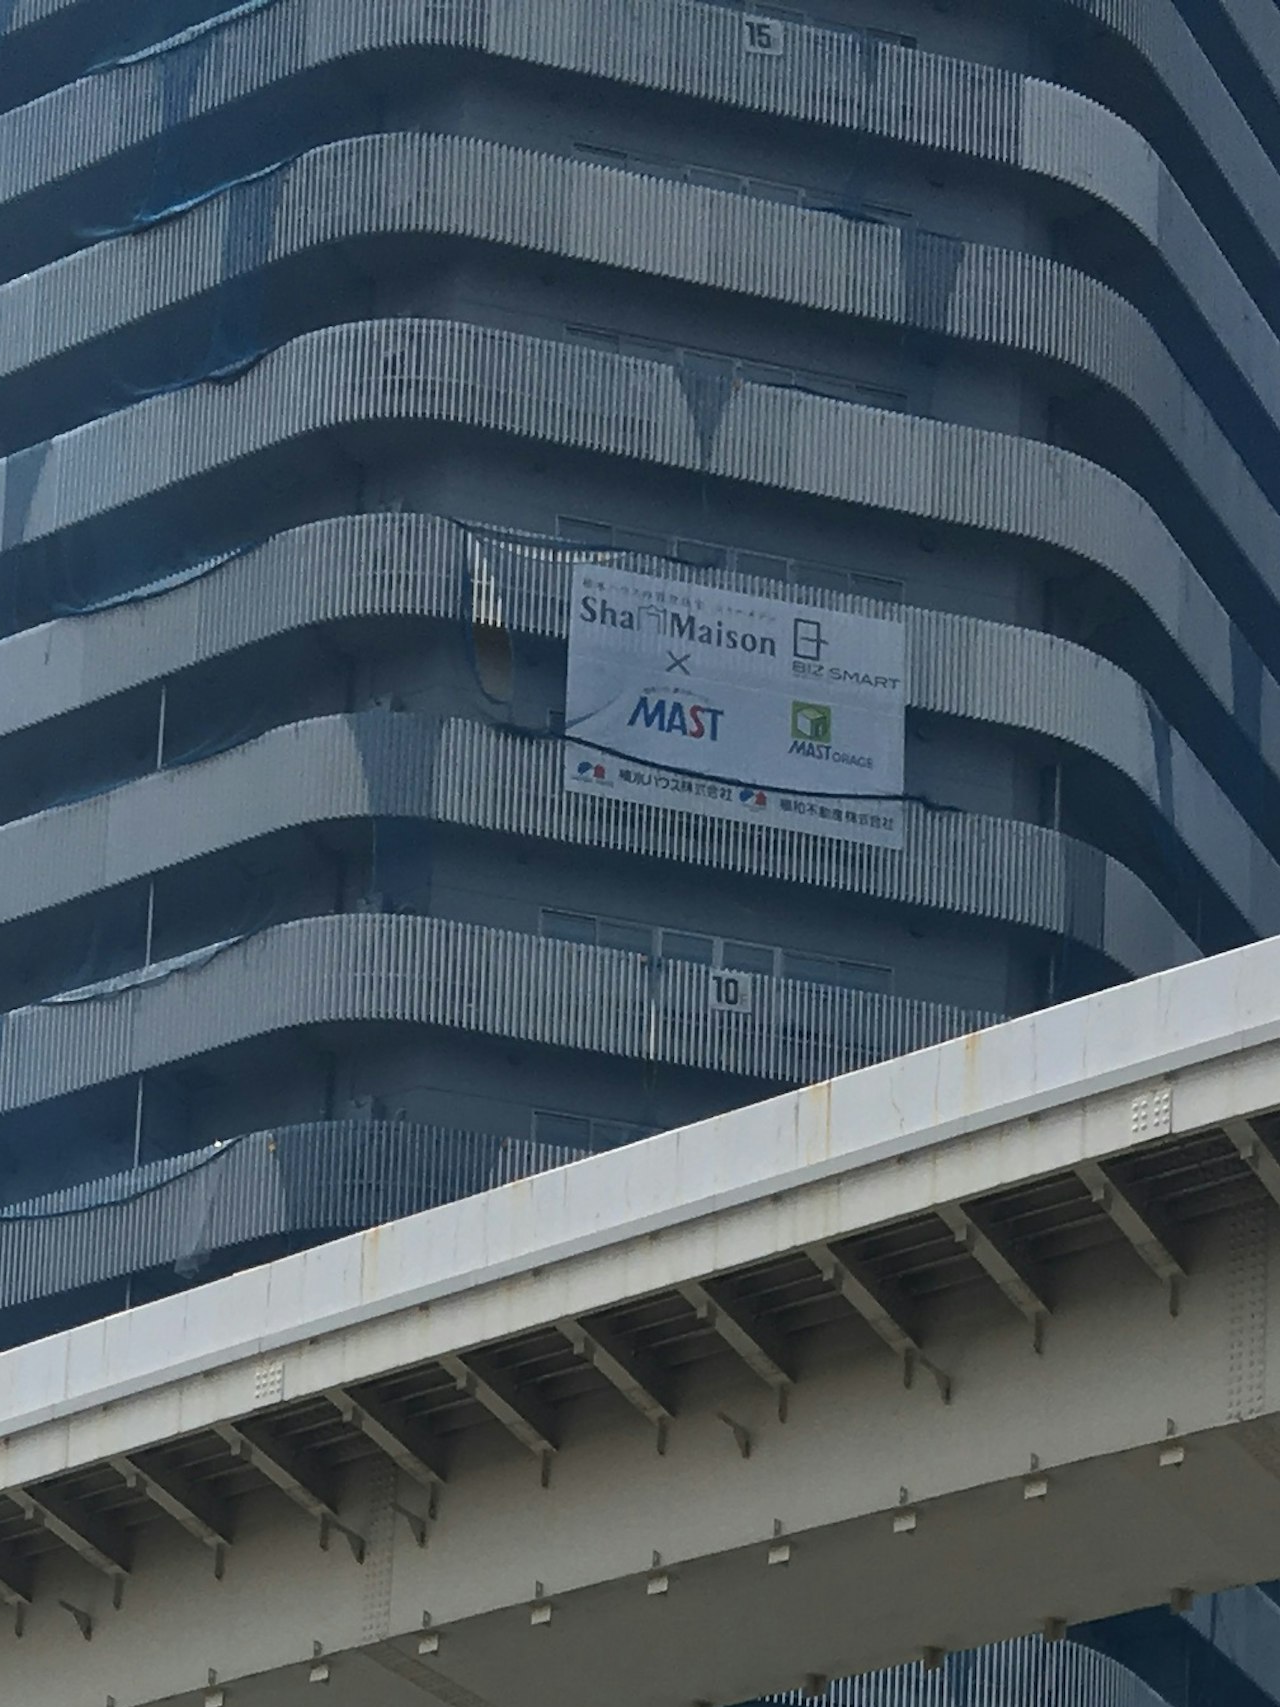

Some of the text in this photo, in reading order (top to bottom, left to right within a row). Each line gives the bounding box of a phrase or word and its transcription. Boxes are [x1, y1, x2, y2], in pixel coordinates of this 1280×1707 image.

[792, 660, 902, 690] BIZ SMART
[626, 695, 725, 742] MAST
